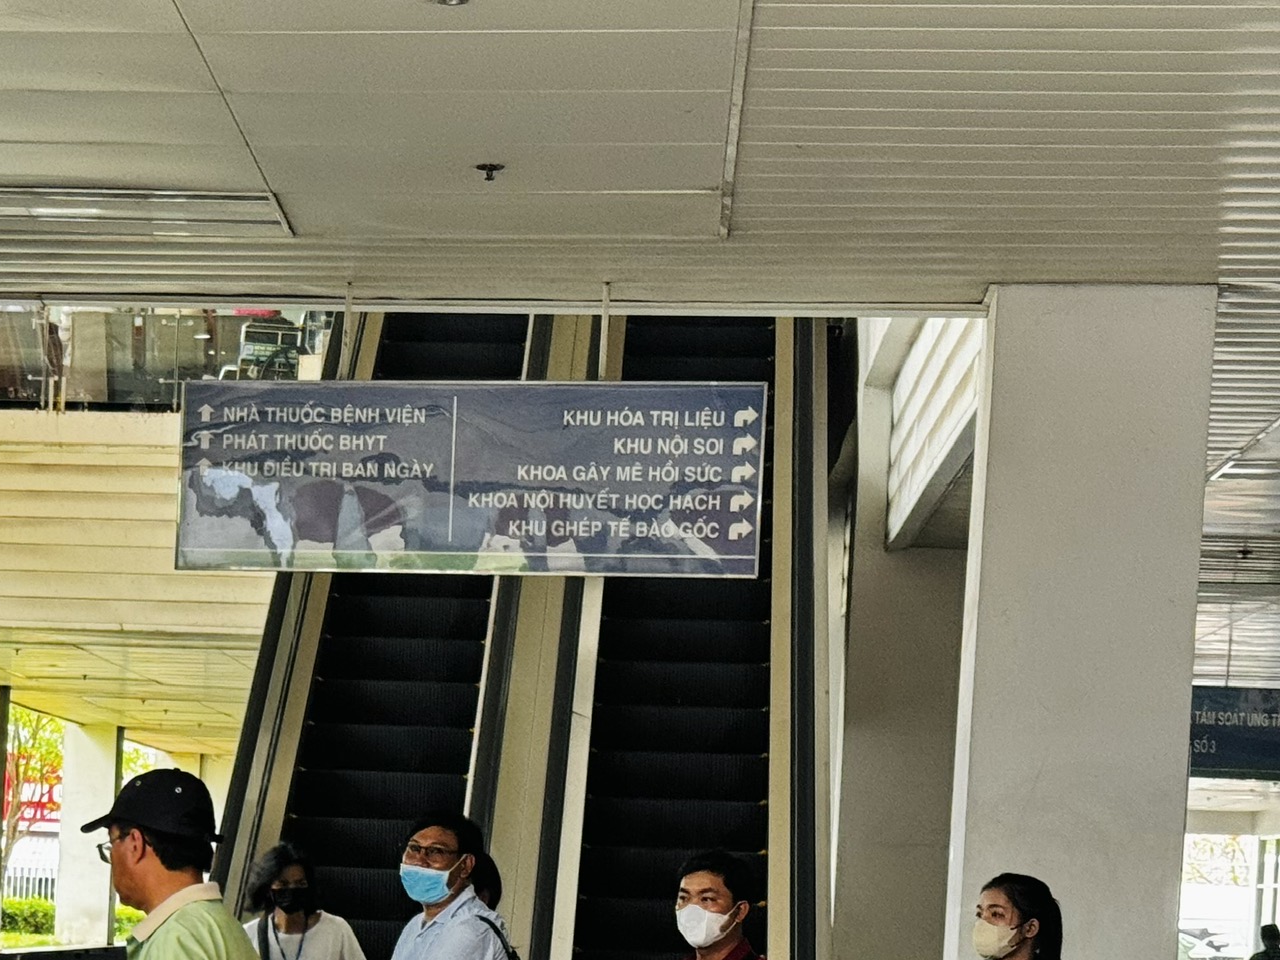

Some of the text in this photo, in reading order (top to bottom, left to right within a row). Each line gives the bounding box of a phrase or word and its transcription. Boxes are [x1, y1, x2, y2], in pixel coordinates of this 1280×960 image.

[223, 400, 426, 427] NHÀ THUỐC BỆNH VIỆN
[563, 407, 725, 430] KHU HÓA TRỊ LIỆU
[223, 428, 388, 451] PHÁT THUỐC BHYT
[613, 434, 724, 458] KHU NỘI SOI
[221, 455, 434, 480] KHU ĐIỀU TRỊ BAN NGÀY
[517, 460, 723, 483] KHOA GÂY MÊ HỒI SỨC
[468, 488, 721, 514] KHOA NỘI HUYẾT HỌC HẠCH
[509, 520, 547, 537] KHU
[550, 517, 602, 538] GHÉP
[635, 519, 674, 538] BÀO
[678, 515, 720, 538] GỐC
[1210, 740, 1216, 753] 3
